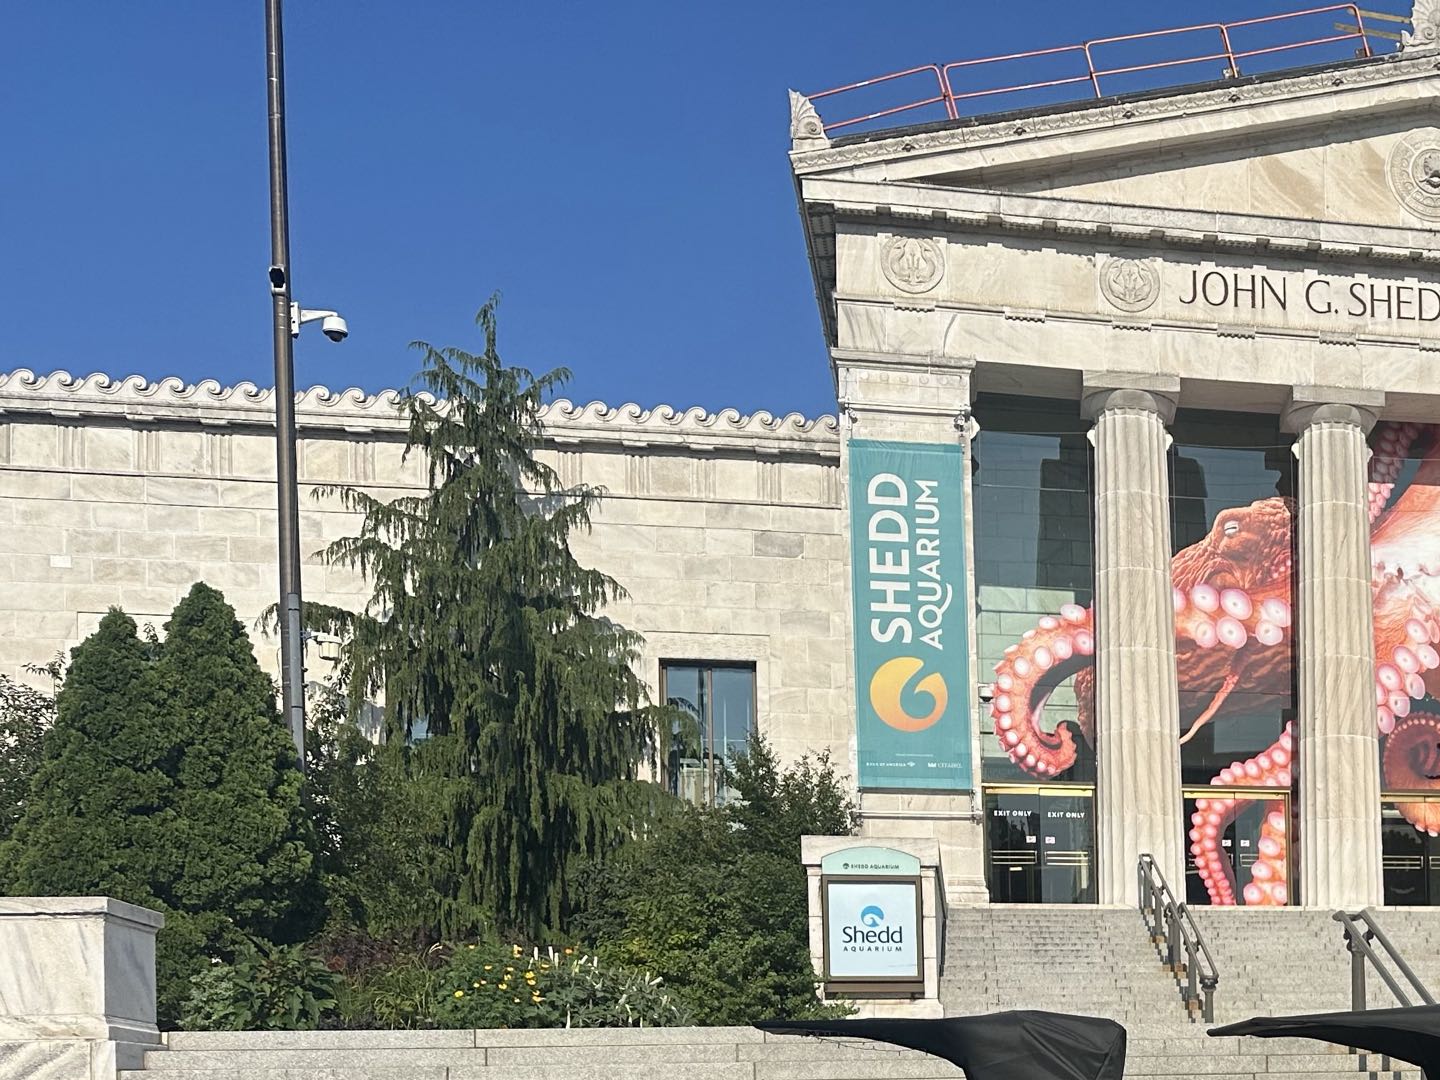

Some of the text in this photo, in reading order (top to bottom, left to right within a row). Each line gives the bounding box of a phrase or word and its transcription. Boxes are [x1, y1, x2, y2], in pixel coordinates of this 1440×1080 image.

[1179, 270, 1287, 311] JOHN
[1305, 280, 1339, 314] G.
[867, 473, 913, 643] SHEDD
[914, 480, 953, 650] AQUARIUM
[842, 926, 903, 943] Shedd
